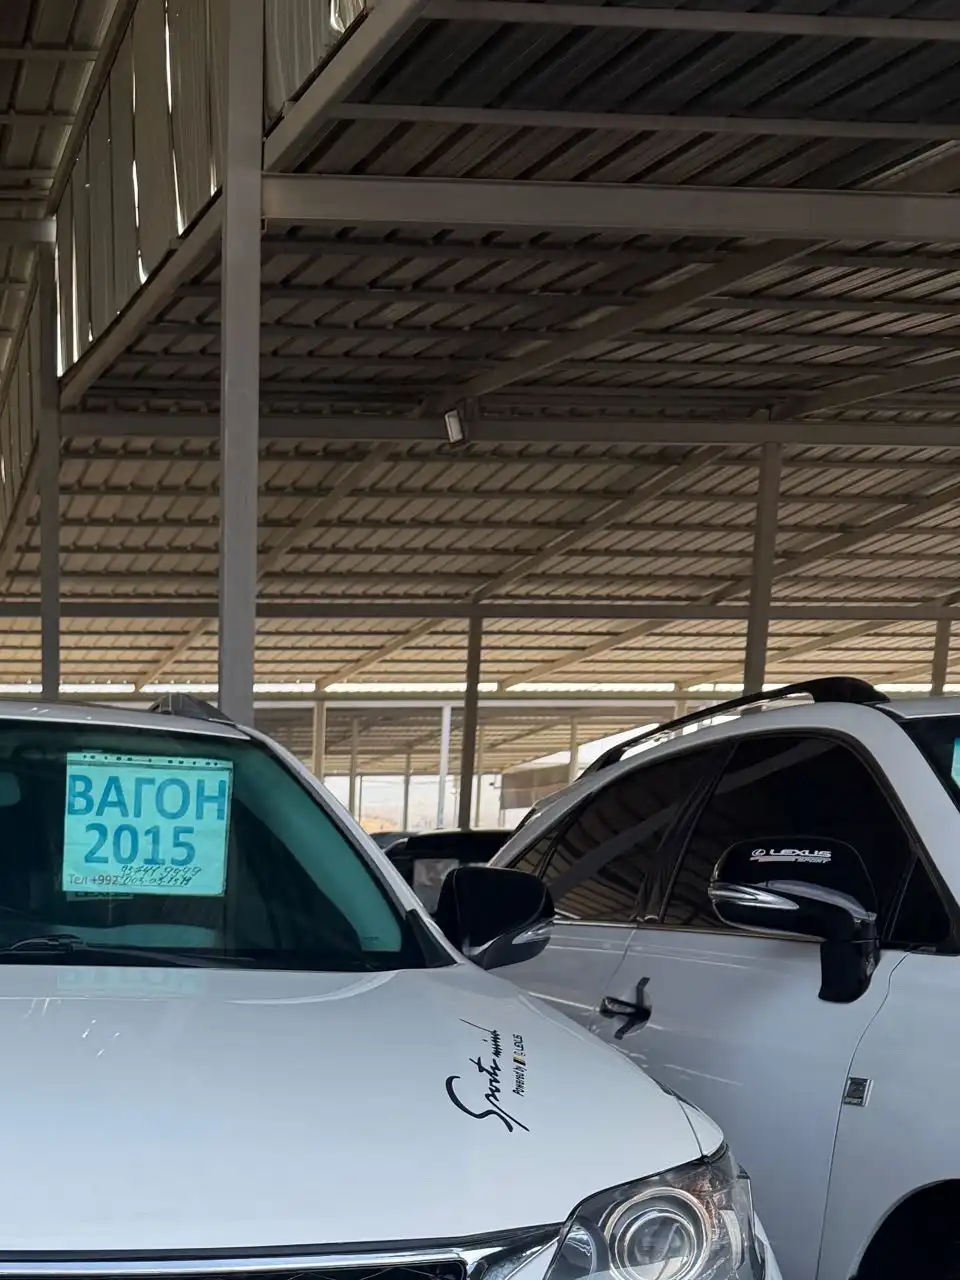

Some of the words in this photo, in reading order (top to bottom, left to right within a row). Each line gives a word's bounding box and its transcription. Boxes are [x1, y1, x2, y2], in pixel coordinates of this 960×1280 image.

[67, 774, 227, 821] ВАГОН
[84, 823, 196, 866] 2015
[769, 849, 831, 858] LEXUS
